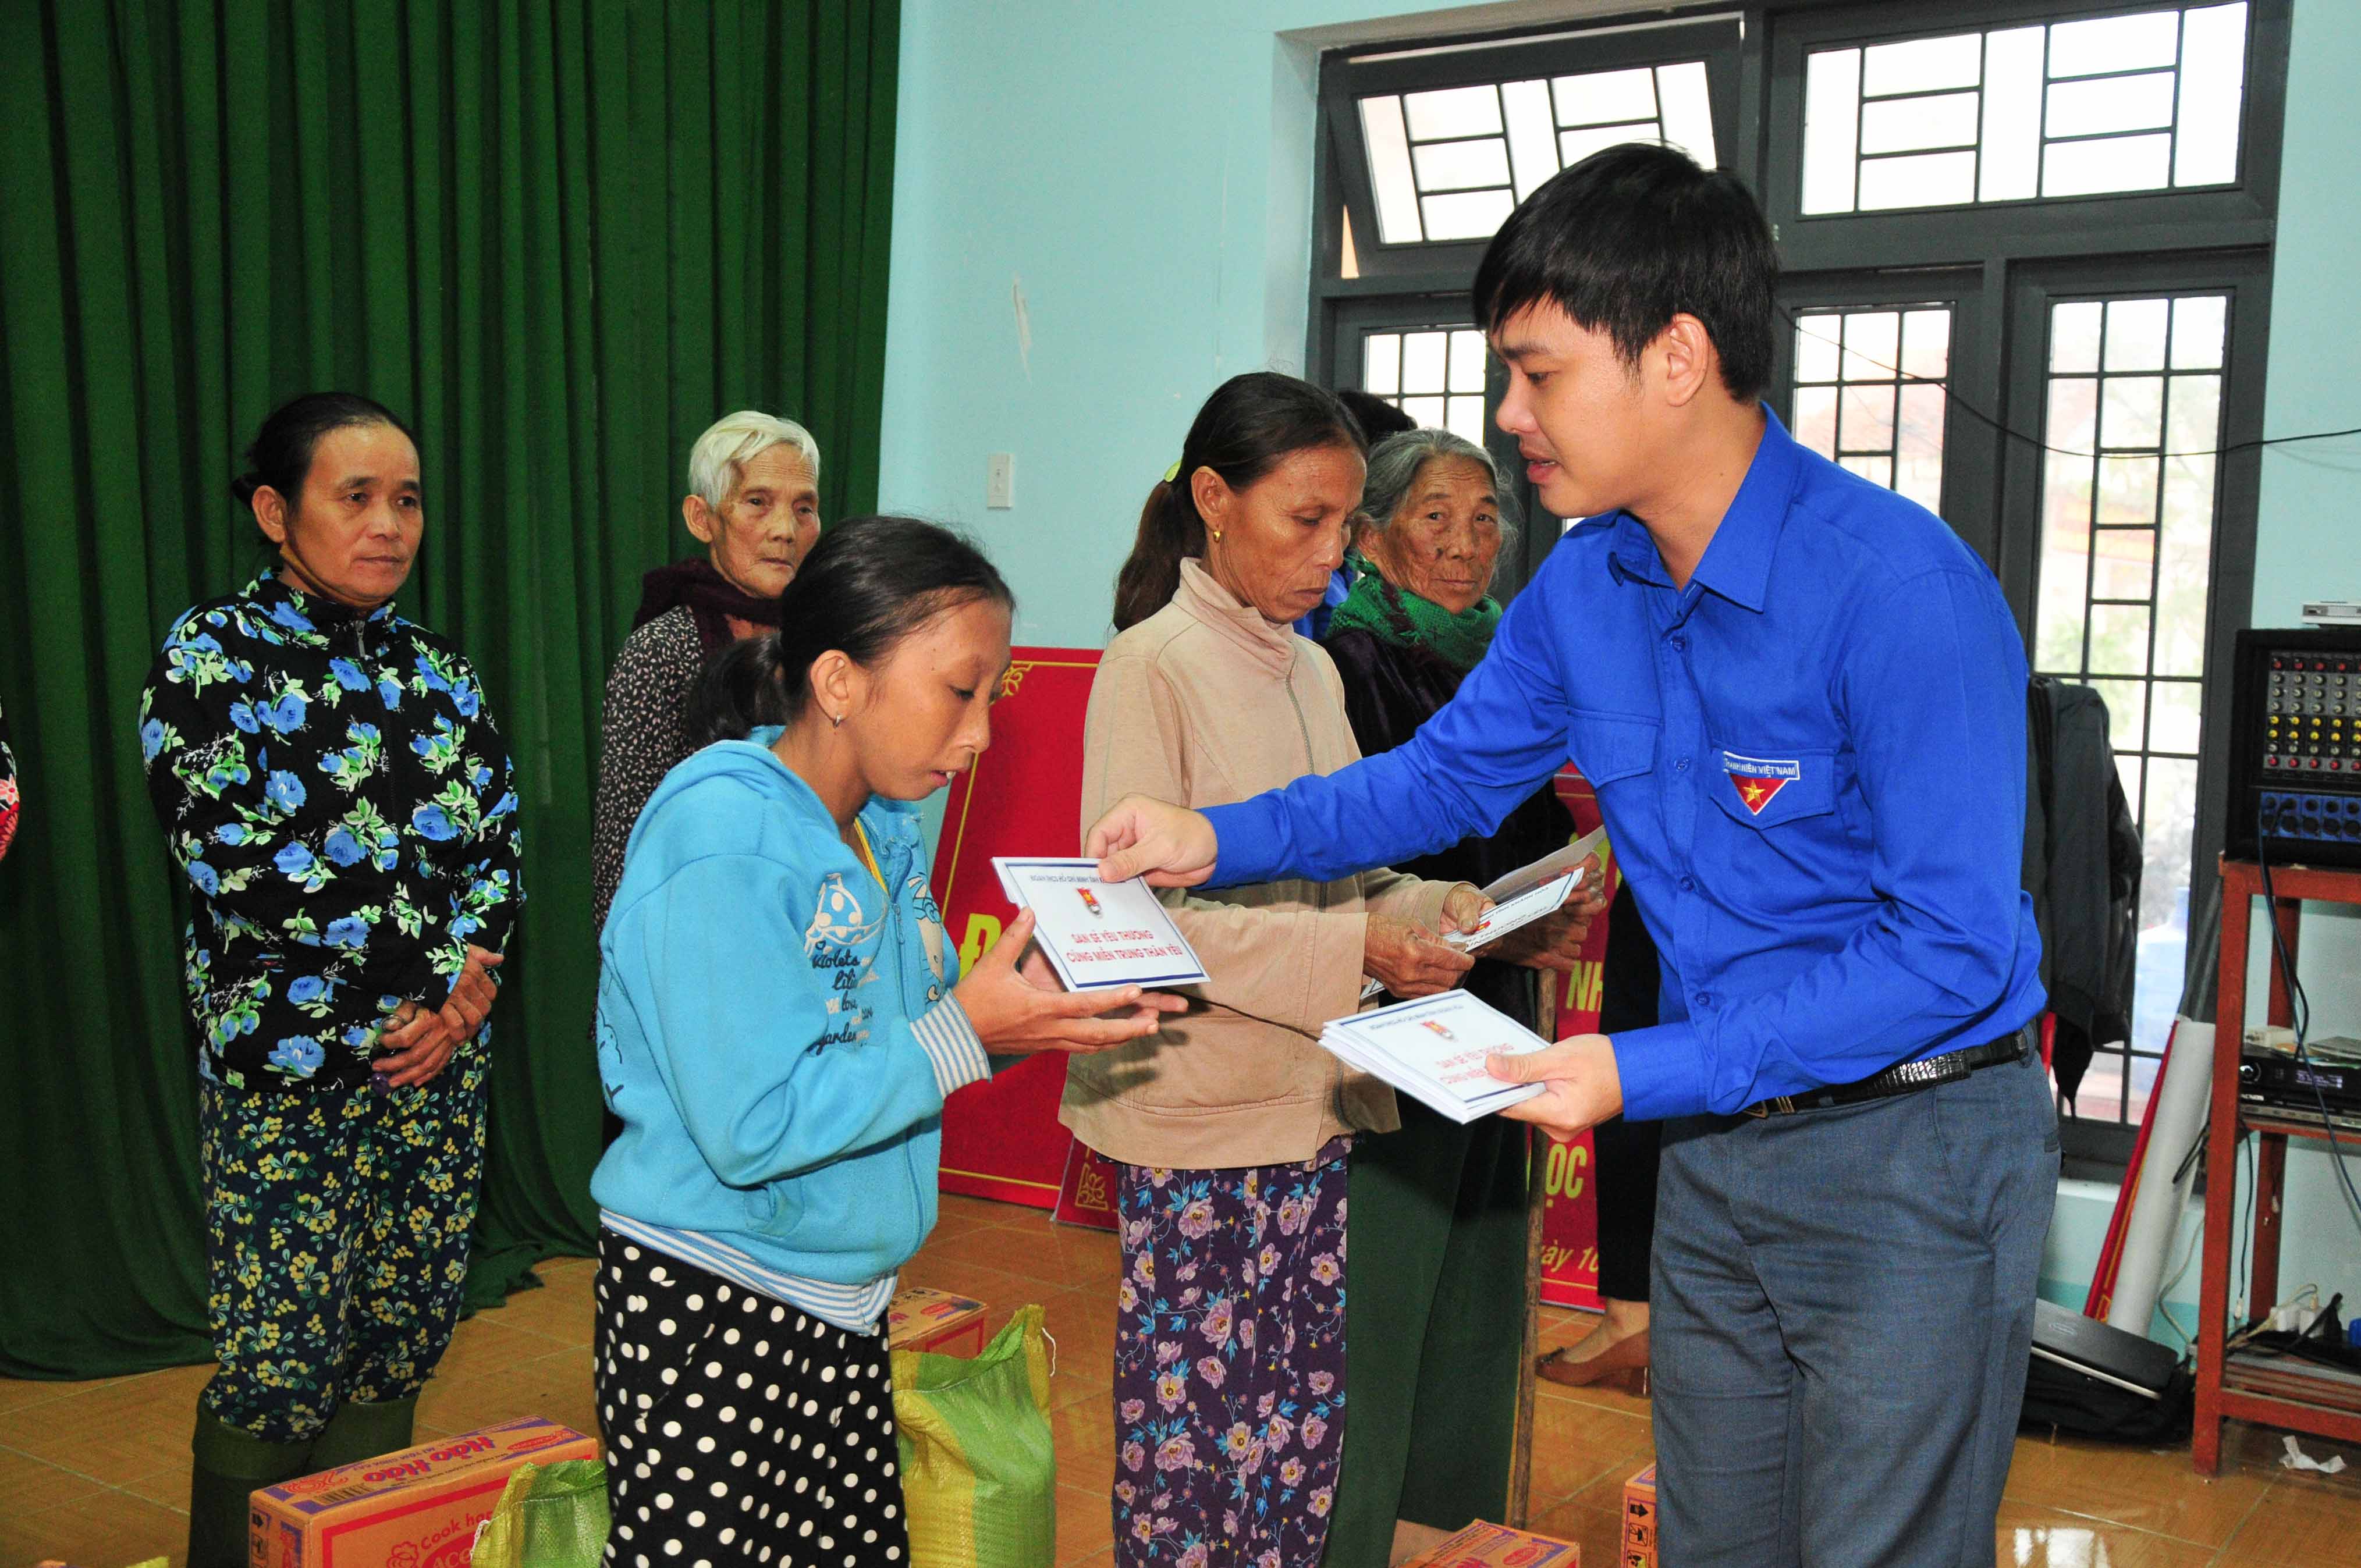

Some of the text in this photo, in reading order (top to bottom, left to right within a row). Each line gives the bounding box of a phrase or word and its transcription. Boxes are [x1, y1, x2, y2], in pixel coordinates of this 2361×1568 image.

[1756, 765, 1776, 778] VIỆT
[1777, 766, 1796, 776] NAM
[1114, 948, 1145, 959] TRUNG
[1544, 1142, 1588, 1208] ỌC
[1541, 1239, 1574, 1273] ày
[421, 1519, 461, 1550] Cook
